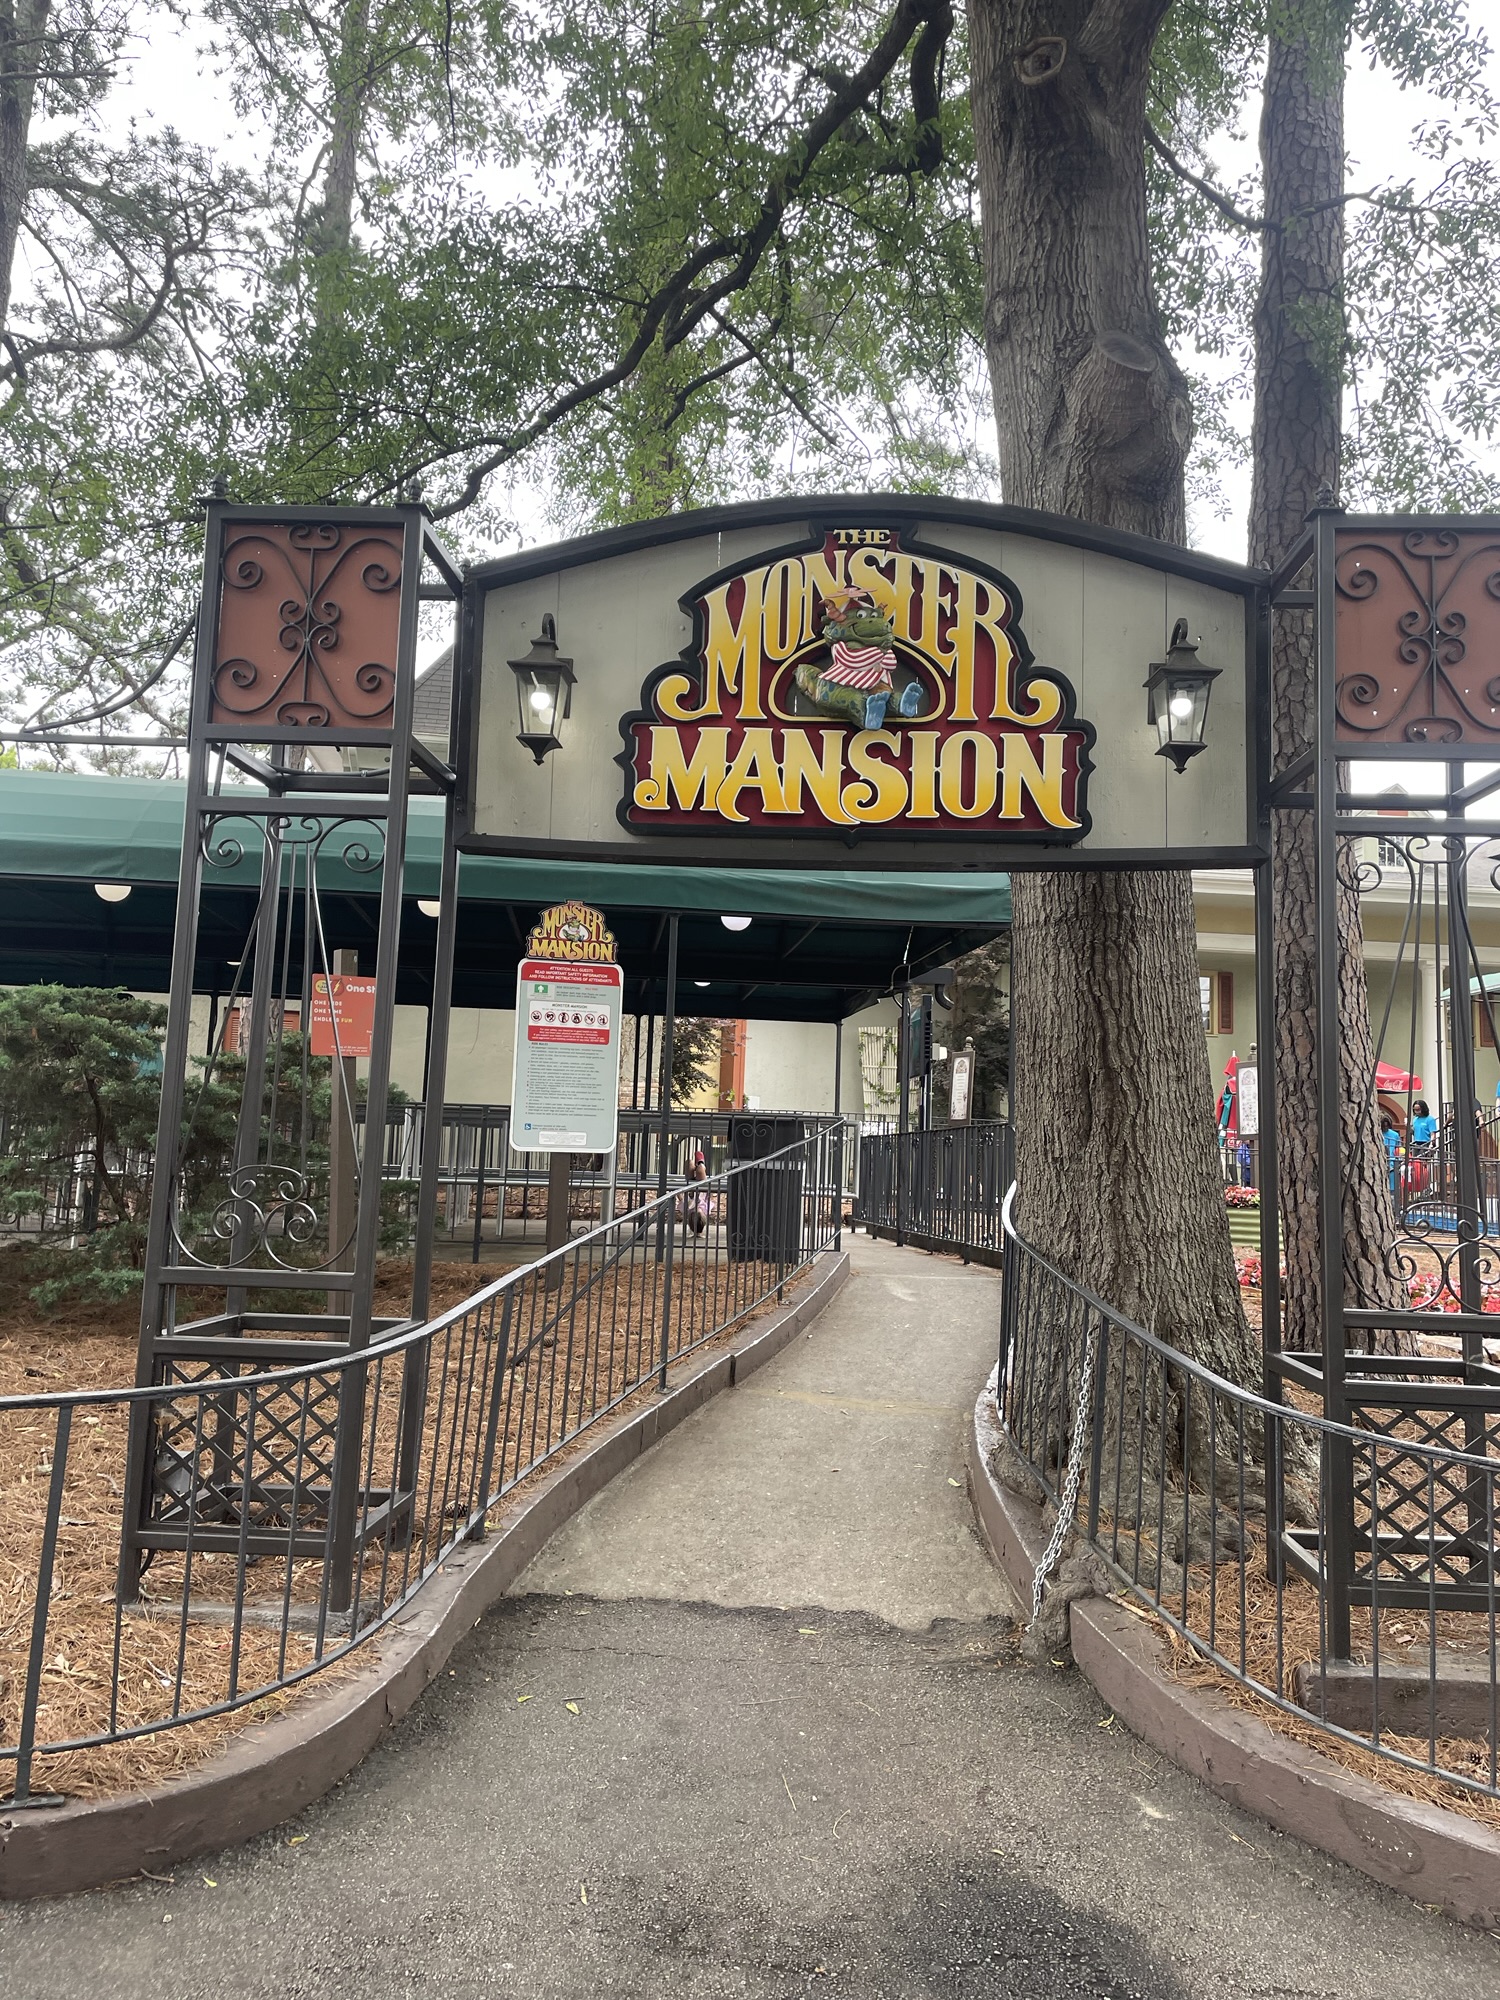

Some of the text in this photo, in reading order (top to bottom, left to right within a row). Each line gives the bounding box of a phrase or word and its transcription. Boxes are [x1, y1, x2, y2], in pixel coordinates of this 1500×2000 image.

[833, 528, 891, 545] THE
[657, 547, 1061, 727] MONSTER
[633, 725, 1083, 830] MANSION
[533, 904, 614, 943] MONSTER
[528, 938, 616, 962] MANSION
[346, 984, 365, 993] One
